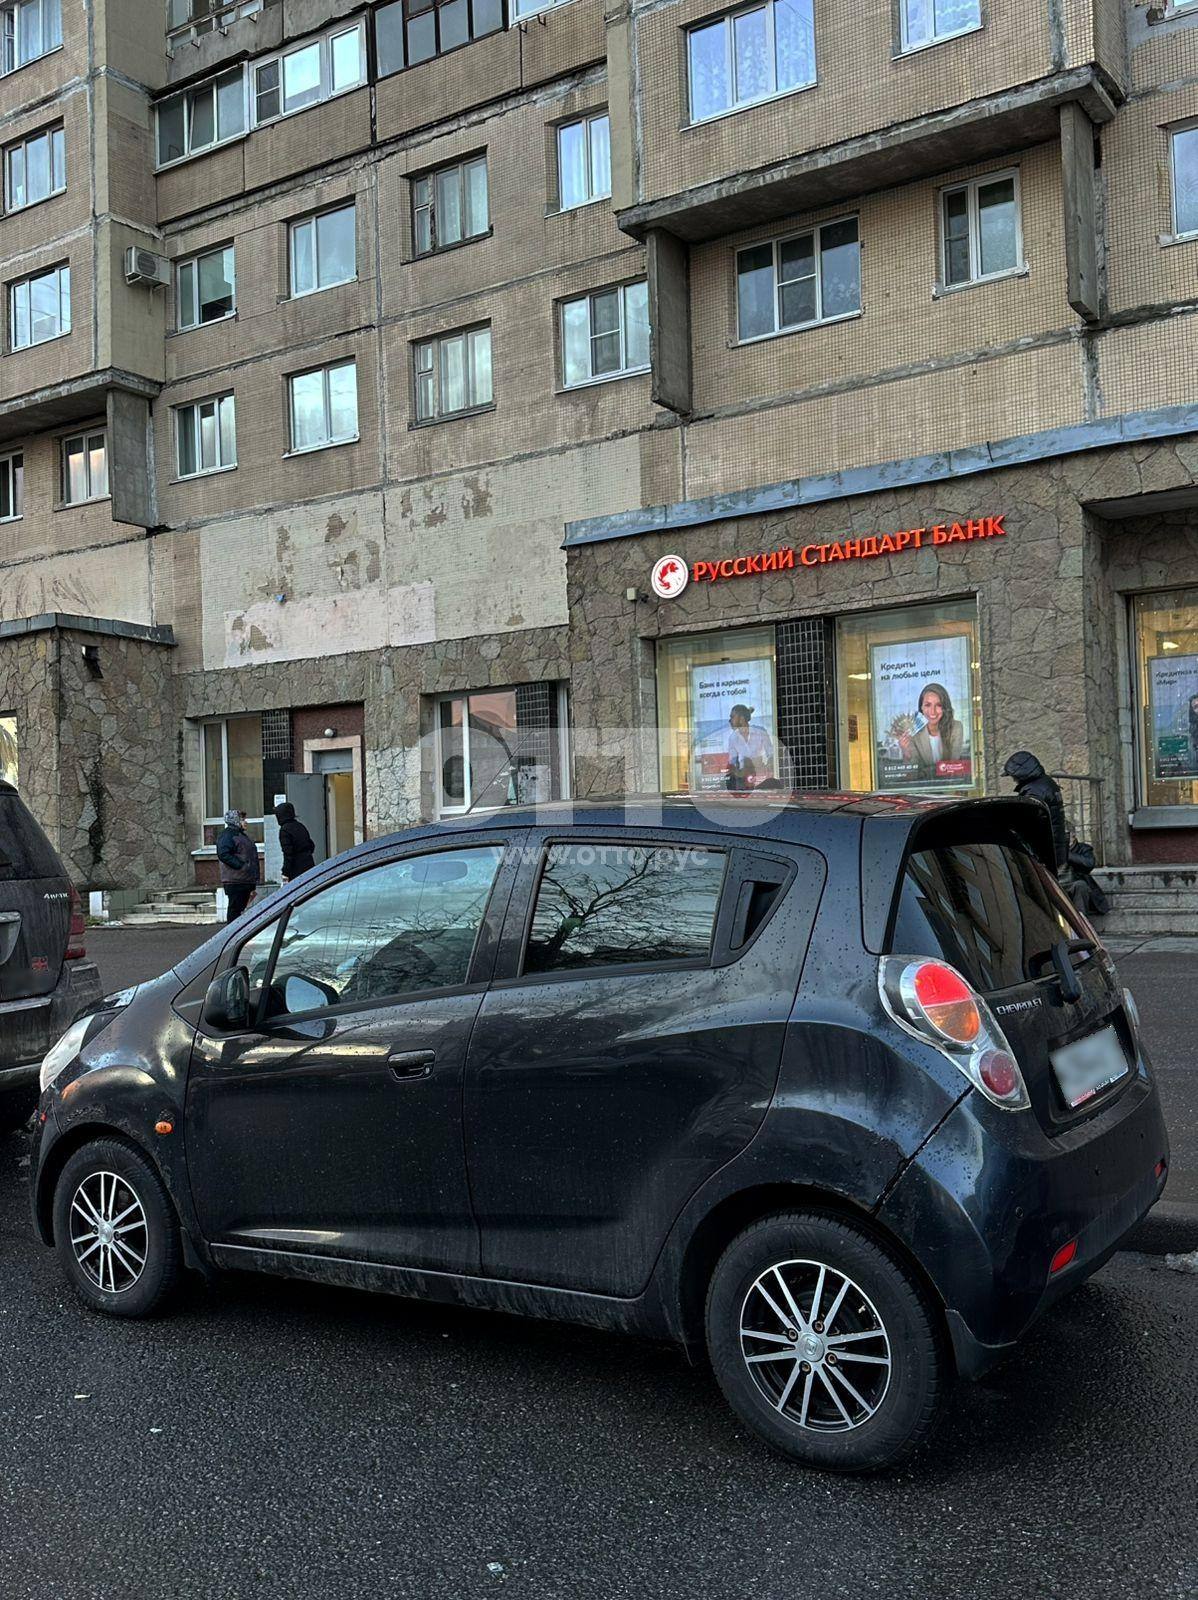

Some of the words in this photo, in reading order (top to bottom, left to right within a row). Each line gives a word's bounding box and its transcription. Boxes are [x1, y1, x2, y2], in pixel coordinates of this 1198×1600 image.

[692, 546, 794, 583] РУССКИЙ
[800, 527, 926, 566] СТАНДАРТ
[932, 514, 1006, 545] БАНК
[880, 661, 916, 671] Кредиты
[880, 673, 891, 681] на
[892, 670, 919, 680] любые
[920, 669, 941, 678] цели
[699, 681, 715, 689] Банк
[699, 691, 720, 699] всегда
[727, 687, 747, 696] тобой
[996, 998, 1043, 1015] CHEVROLET
